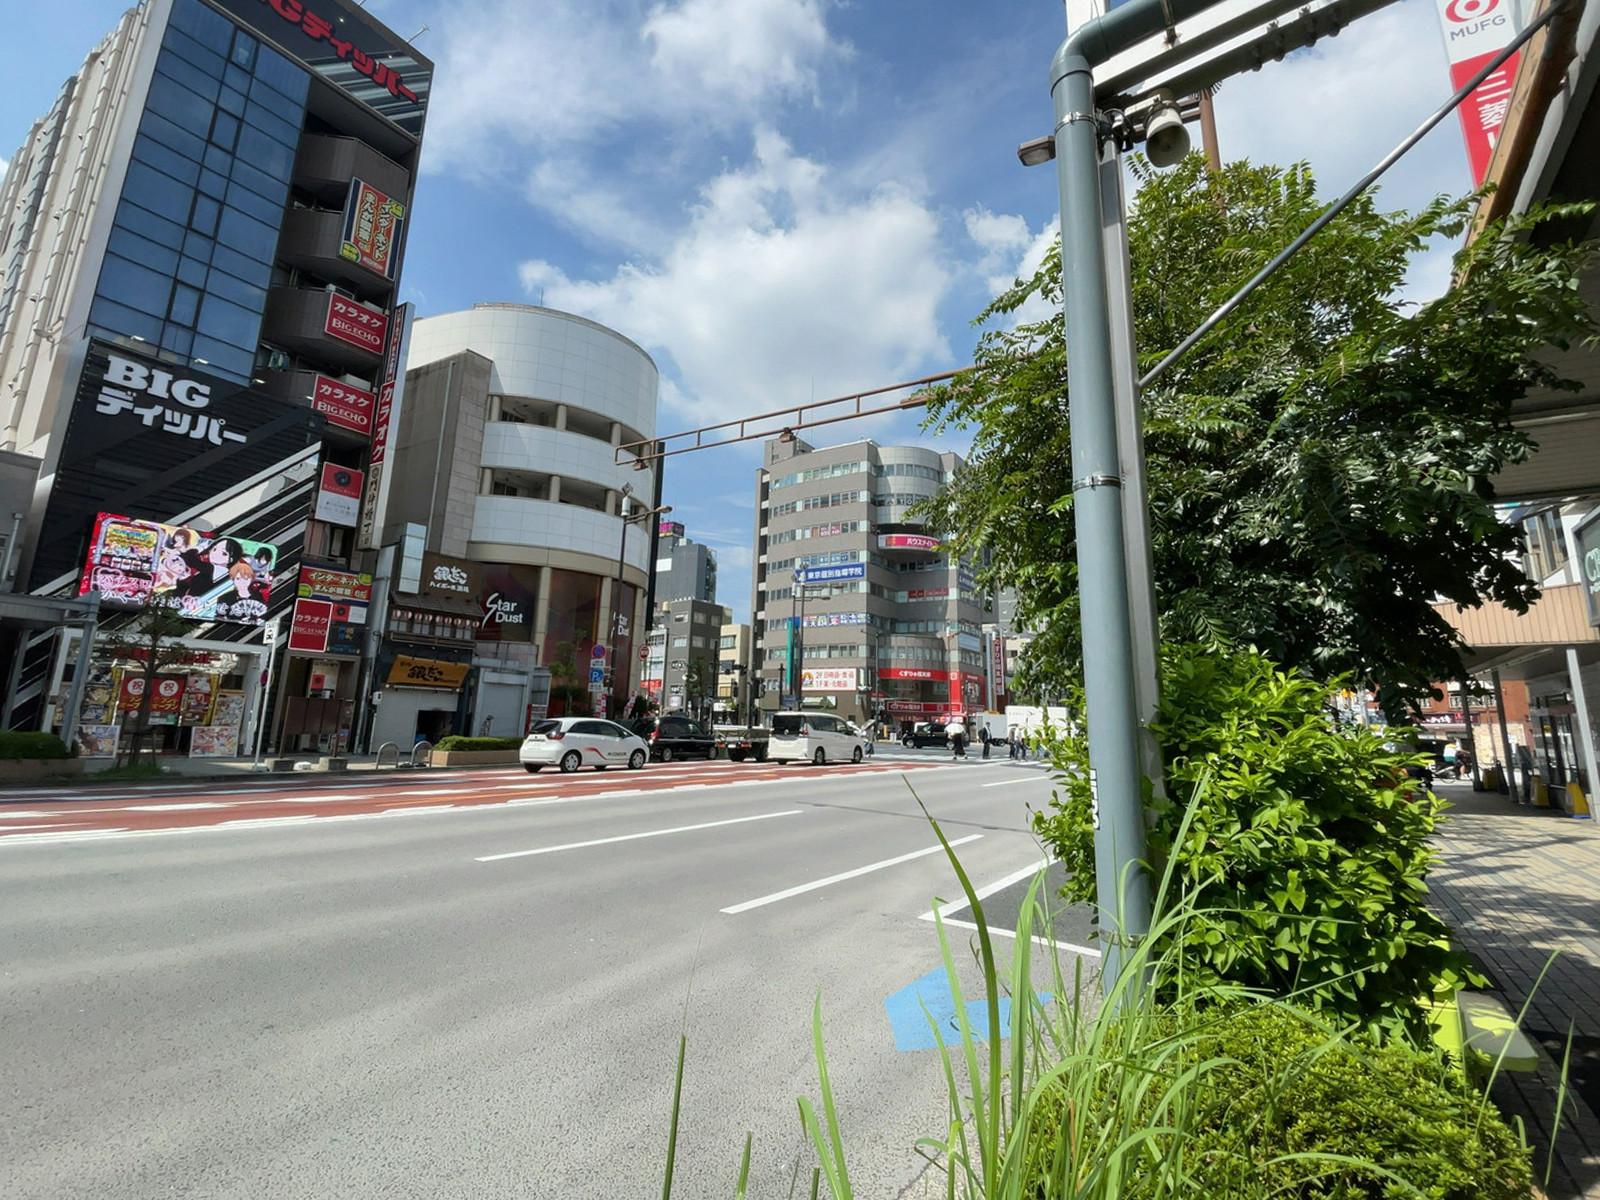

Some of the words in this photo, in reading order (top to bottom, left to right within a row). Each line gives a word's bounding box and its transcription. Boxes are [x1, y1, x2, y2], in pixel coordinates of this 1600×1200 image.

[1450, 15, 1506, 41] MUFG
[333, 302, 383, 327] カラオケ
[331, 318, 352, 332] BIG
[353, 328, 380, 345] ECHO
[103, 354, 211, 409] BIG
[319, 384, 370, 407] カラオケ
[95, 385, 248, 446] ディッパー
[317, 401, 338, 415] BIG
[339, 409, 368, 425] ECHO
[373, 387, 393, 461] カラオケ
[309, 572, 360, 586] インターネット
[433, 565, 468, 585] 銀だこ
[295, 614, 328, 624] カラオケ
[481, 592, 517, 630] Star
[495, 612, 523, 624] Dust
[408, 664, 443, 682] 銀だこ
[132, 681, 144, 691] 祝
[164, 682, 174, 692] 祝
